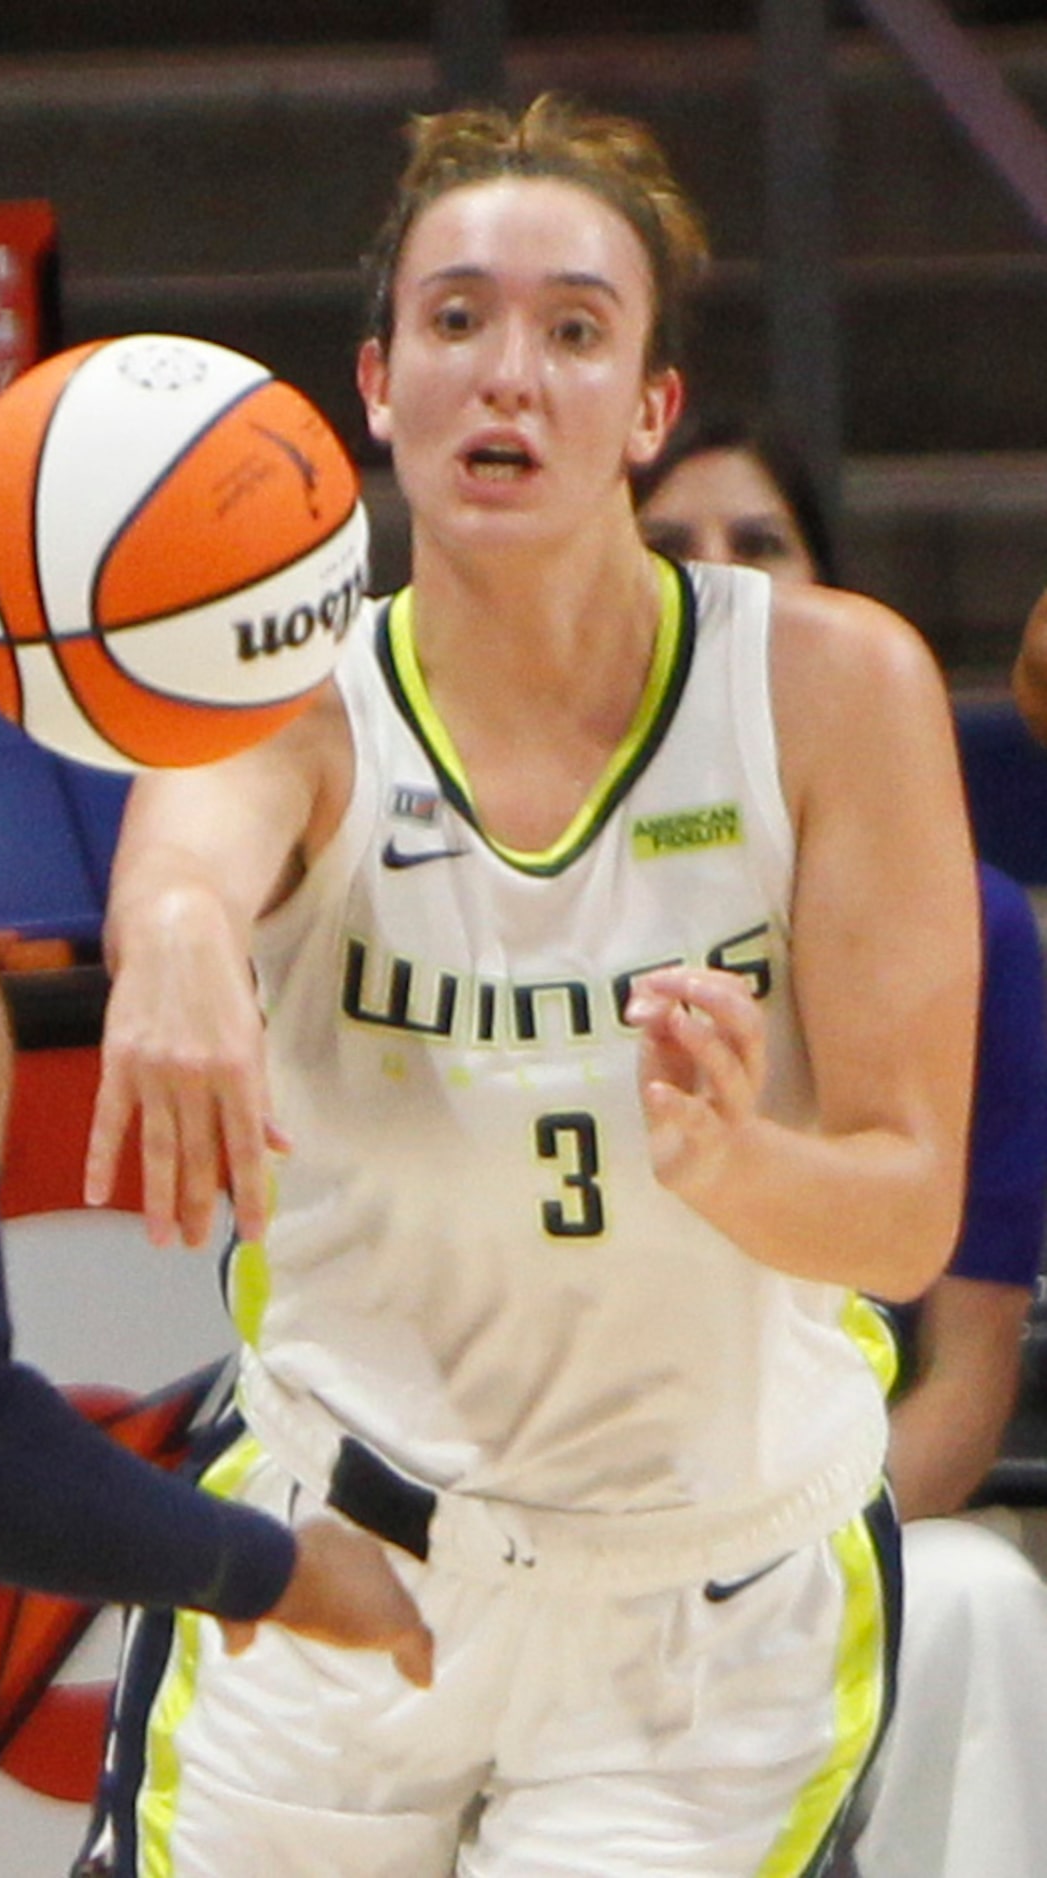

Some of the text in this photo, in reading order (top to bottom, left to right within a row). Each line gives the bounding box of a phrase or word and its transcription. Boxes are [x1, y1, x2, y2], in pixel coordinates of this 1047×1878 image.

[634, 804, 737, 838] AMERICAN
[653, 826, 736, 850] FIDELITY
[536, 1111, 605, 1238] 3
